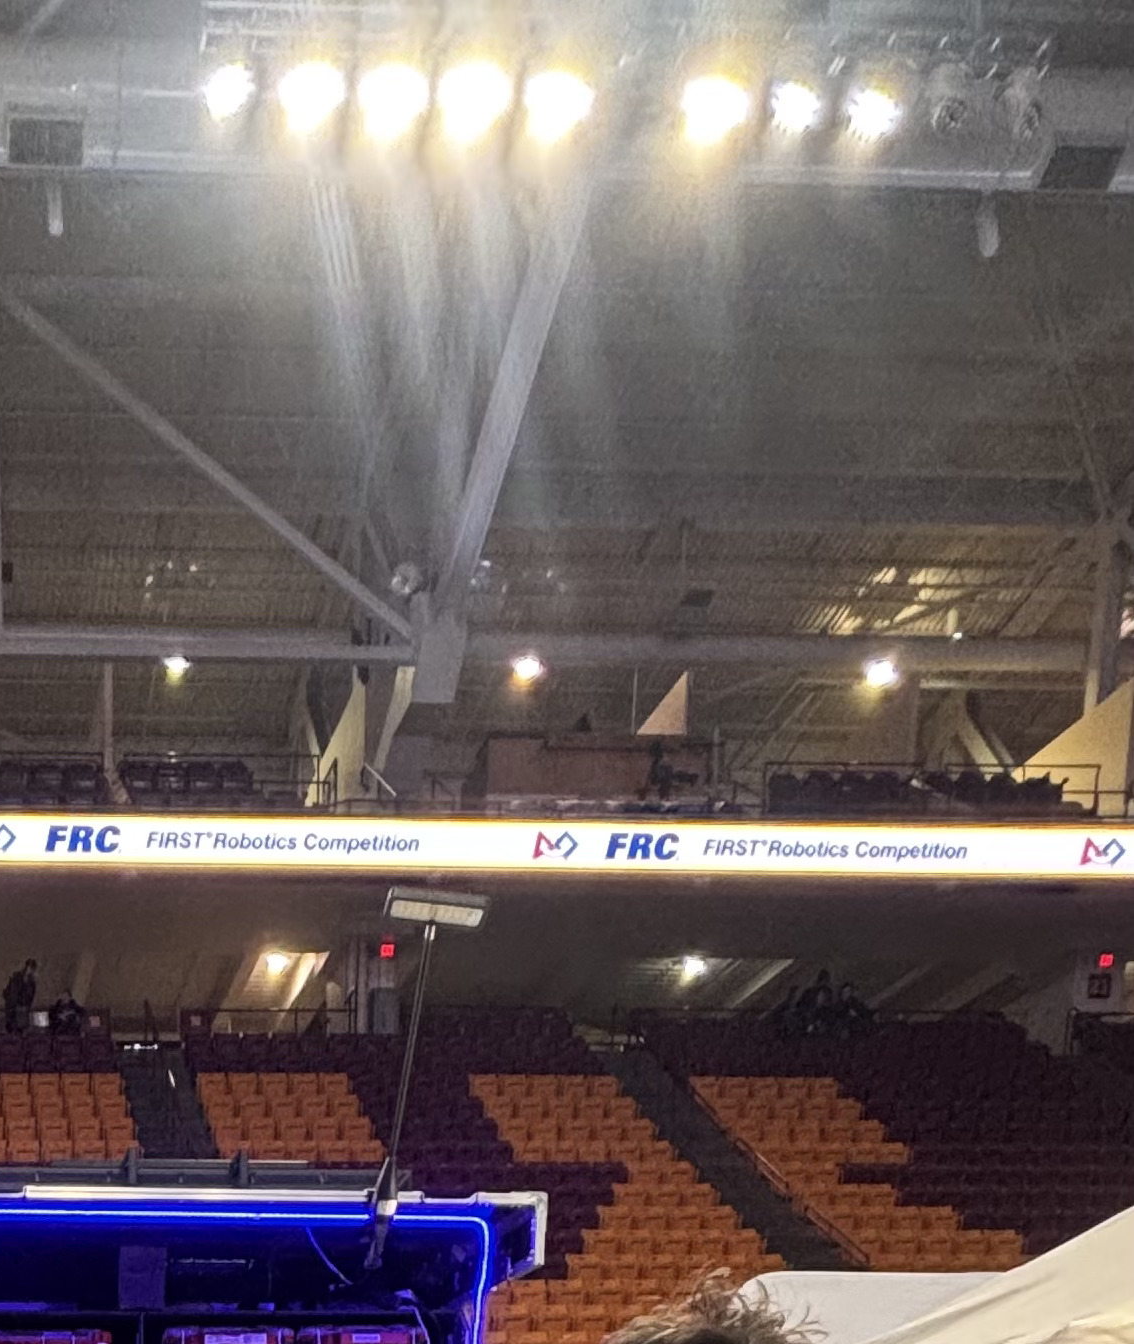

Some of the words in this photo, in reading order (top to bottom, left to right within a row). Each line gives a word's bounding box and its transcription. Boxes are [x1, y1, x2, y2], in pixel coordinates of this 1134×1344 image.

[45, 825, 121, 853] FRC
[214, 832, 297, 850] Robotics
[304, 833, 420, 854] Competition
[605, 832, 680, 860] FRC
[769, 839, 849, 857] Robotics
[855, 841, 968, 862] Competition
